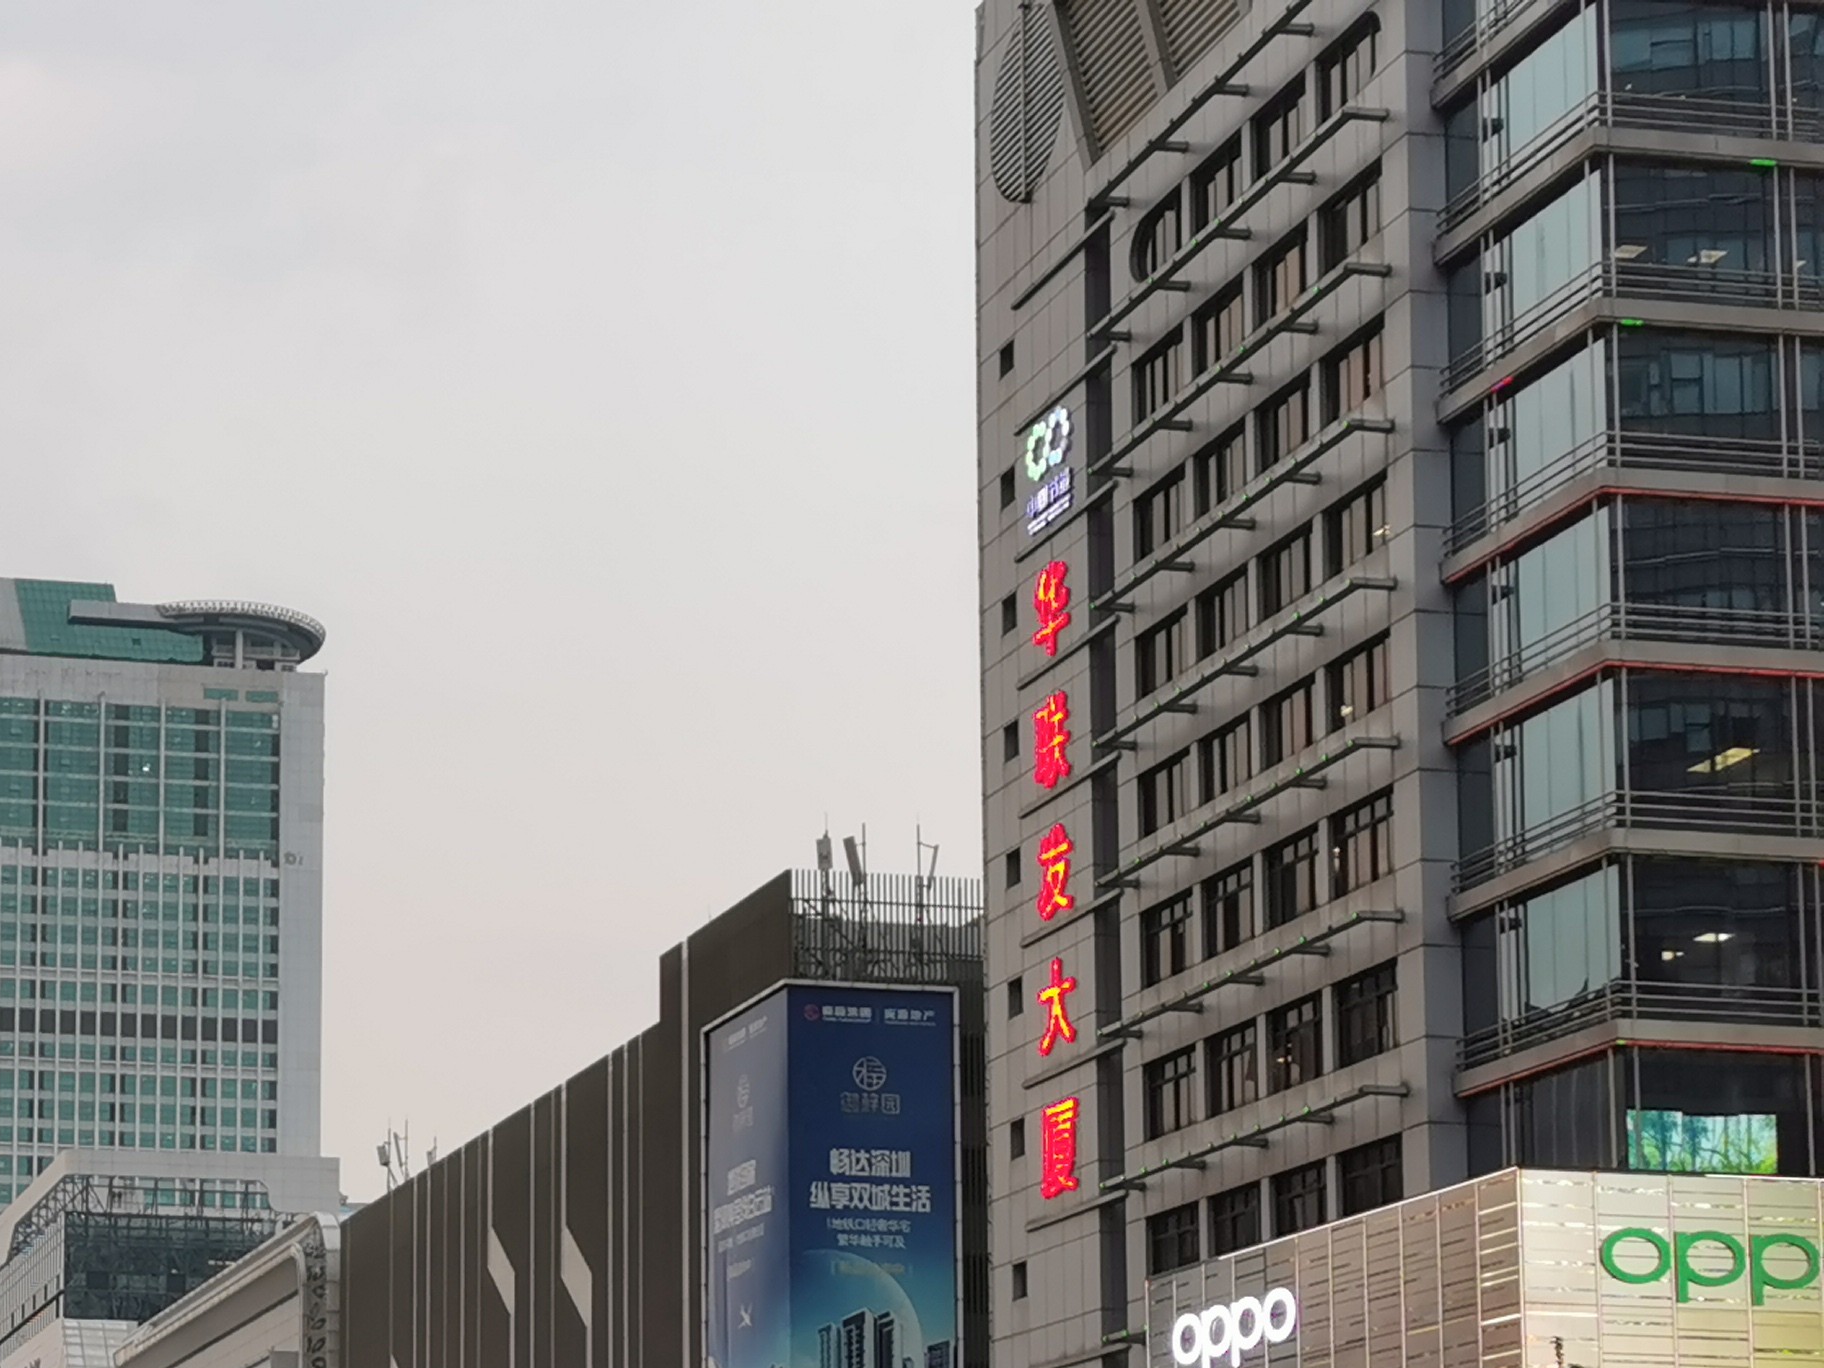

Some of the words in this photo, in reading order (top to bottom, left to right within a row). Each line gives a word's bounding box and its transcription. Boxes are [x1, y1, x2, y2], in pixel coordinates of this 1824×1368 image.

[829, 1148, 911, 1178] 畅达深圳
[809, 1181, 931, 1213] 纵享双城生活
